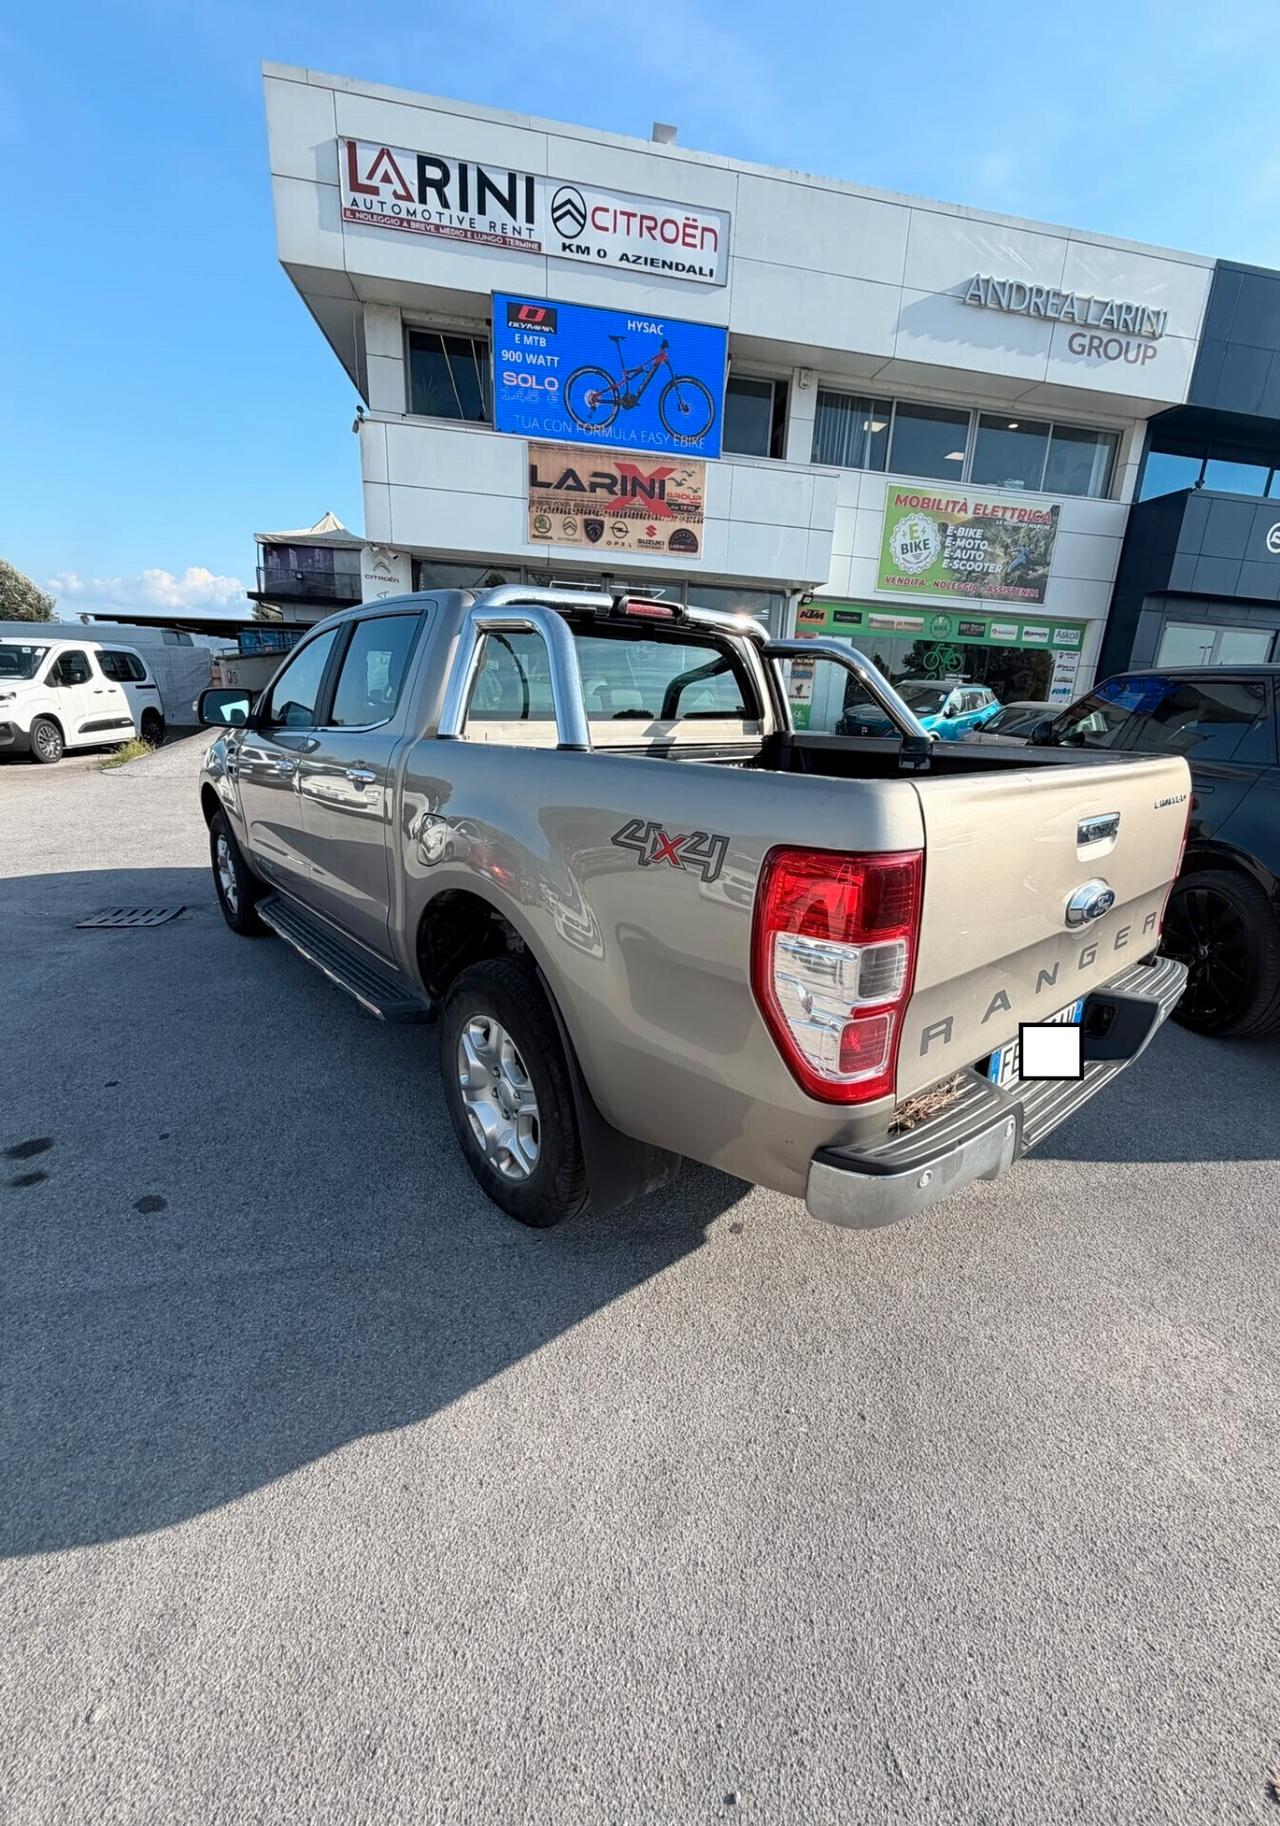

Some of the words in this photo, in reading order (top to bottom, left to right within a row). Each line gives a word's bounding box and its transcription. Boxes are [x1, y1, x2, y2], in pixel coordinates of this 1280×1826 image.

[347, 140, 535, 225] LARINI
[350, 197, 477, 229] AUTOMOTIVE
[489, 221, 535, 239] RENT
[345, 210, 353, 218] IL
[355, 212, 400, 226] NOLEGGIO
[439, 227, 465, 238] MEDIO
[467, 231, 472, 239] E
[474, 233, 503, 244] LUNGO
[505, 238, 540, 250] TERMINE
[591, 206, 718, 253] CITROËN
[561, 242, 590, 256] KM
[618, 253, 714, 278] AZIENDALI
[964, 273, 1079, 324] ANDREA
[1086, 295, 1169, 339] LARINI
[627, 319, 664, 336] HYSAC
[515, 334, 521, 344] E
[523, 334, 547, 347] MTB
[1068, 332, 1158, 366] GROUP
[501, 349, 523, 363] 900
[525, 352, 560, 368] WATT
[503, 371, 559, 391] SOLO
[513, 414, 541, 430] TUA
[543, 420, 572, 433] CON
[576, 423, 638, 442] FORMULA
[641, 431, 670, 446] EASY
[530, 464, 666, 501] LARINI
[894, 494, 969, 515] MOBILITÀ
[972, 503, 1052, 524] ELETTRICA
[909, 522, 920, 540] E
[947, 526, 983, 539] E-BIKE
[606, 540, 632, 548] OPEL
[901, 538, 931, 555] BIKE
[945, 536, 988, 550] E-MOTO
[944, 548, 984, 561] E-AUTO
[885, 575, 925, 587] VENDITA
[933, 580, 978, 593] NOLEGGIO
[920, 911, 1158, 1056] RANGER
